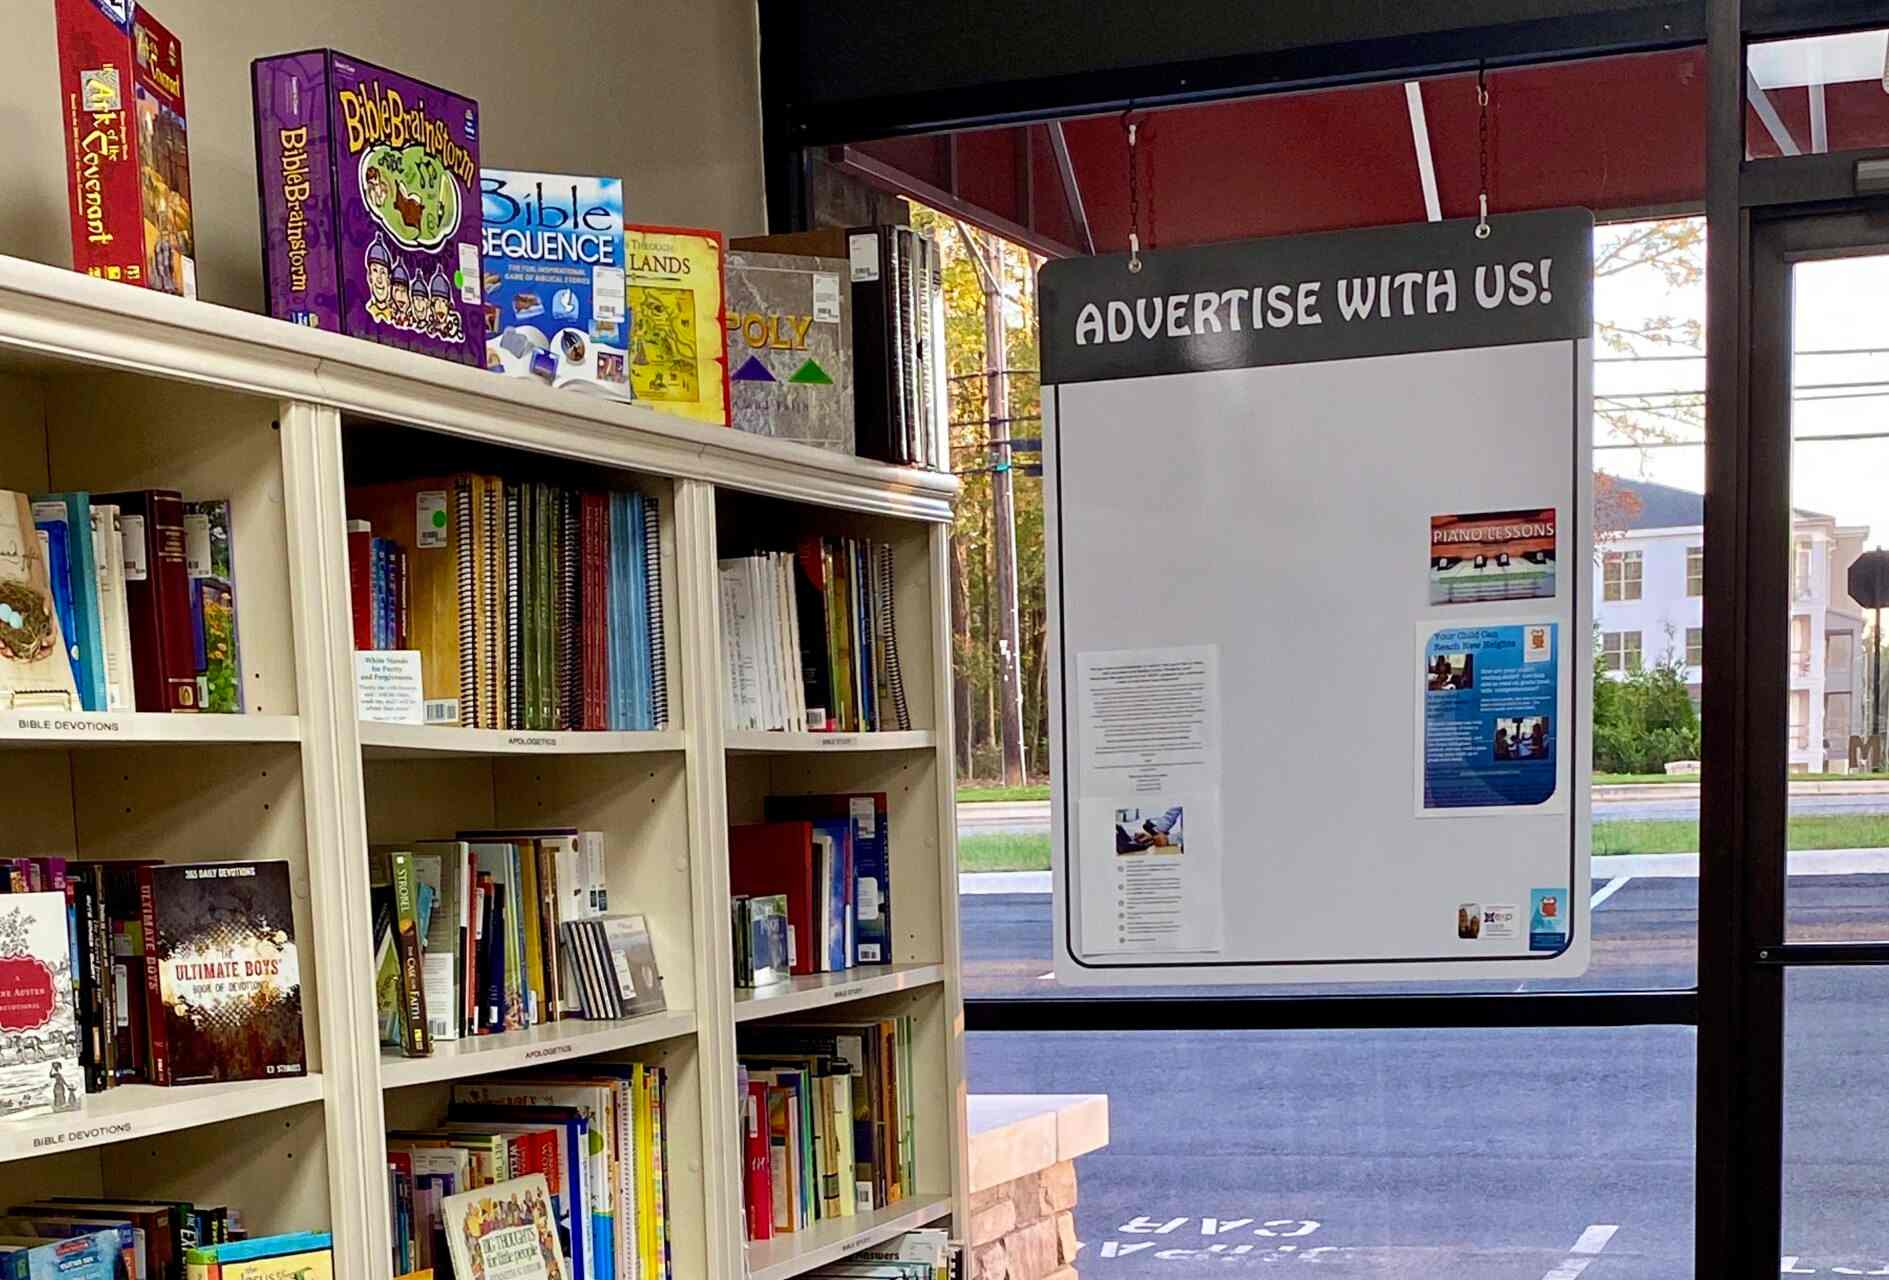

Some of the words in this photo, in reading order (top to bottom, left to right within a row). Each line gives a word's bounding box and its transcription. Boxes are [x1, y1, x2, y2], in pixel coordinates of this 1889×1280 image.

[81, 131, 113, 244] Covenant
[481, 177, 613, 231] Bible
[481, 228, 614, 264] SEQUENCE
[630, 257, 691, 275] LANDS
[1076, 283, 1322, 346] ADVERTISE
[1337, 269, 1457, 321] WITH
[1474, 259, 1552, 309] US!
[1433, 528, 1482, 543] PIANO
[1488, 522, 1554, 540] LESSONS
[1434, 632, 1456, 640] Your
[18, 719, 51, 731] BIBLE
[54, 720, 119, 732] DEVOTIONS
[508, 737, 557, 746] APOLOGETICS
[199, 868, 217, 878] DAILY
[219, 867, 255, 877] DEVOTIONS
[397, 869, 409, 912] STROBEL
[141, 885, 155, 950] ULTIMATE
[175, 962, 242, 981] ULTIMATE
[246, 958, 282, 976] BOYS'
[409, 991, 420, 1019] FAITH
[33, 1135, 66, 1148] BIBLE
[68, 1122, 132, 1143] DEVOTIONS
[1118, 1216, 1320, 1237] CAR
